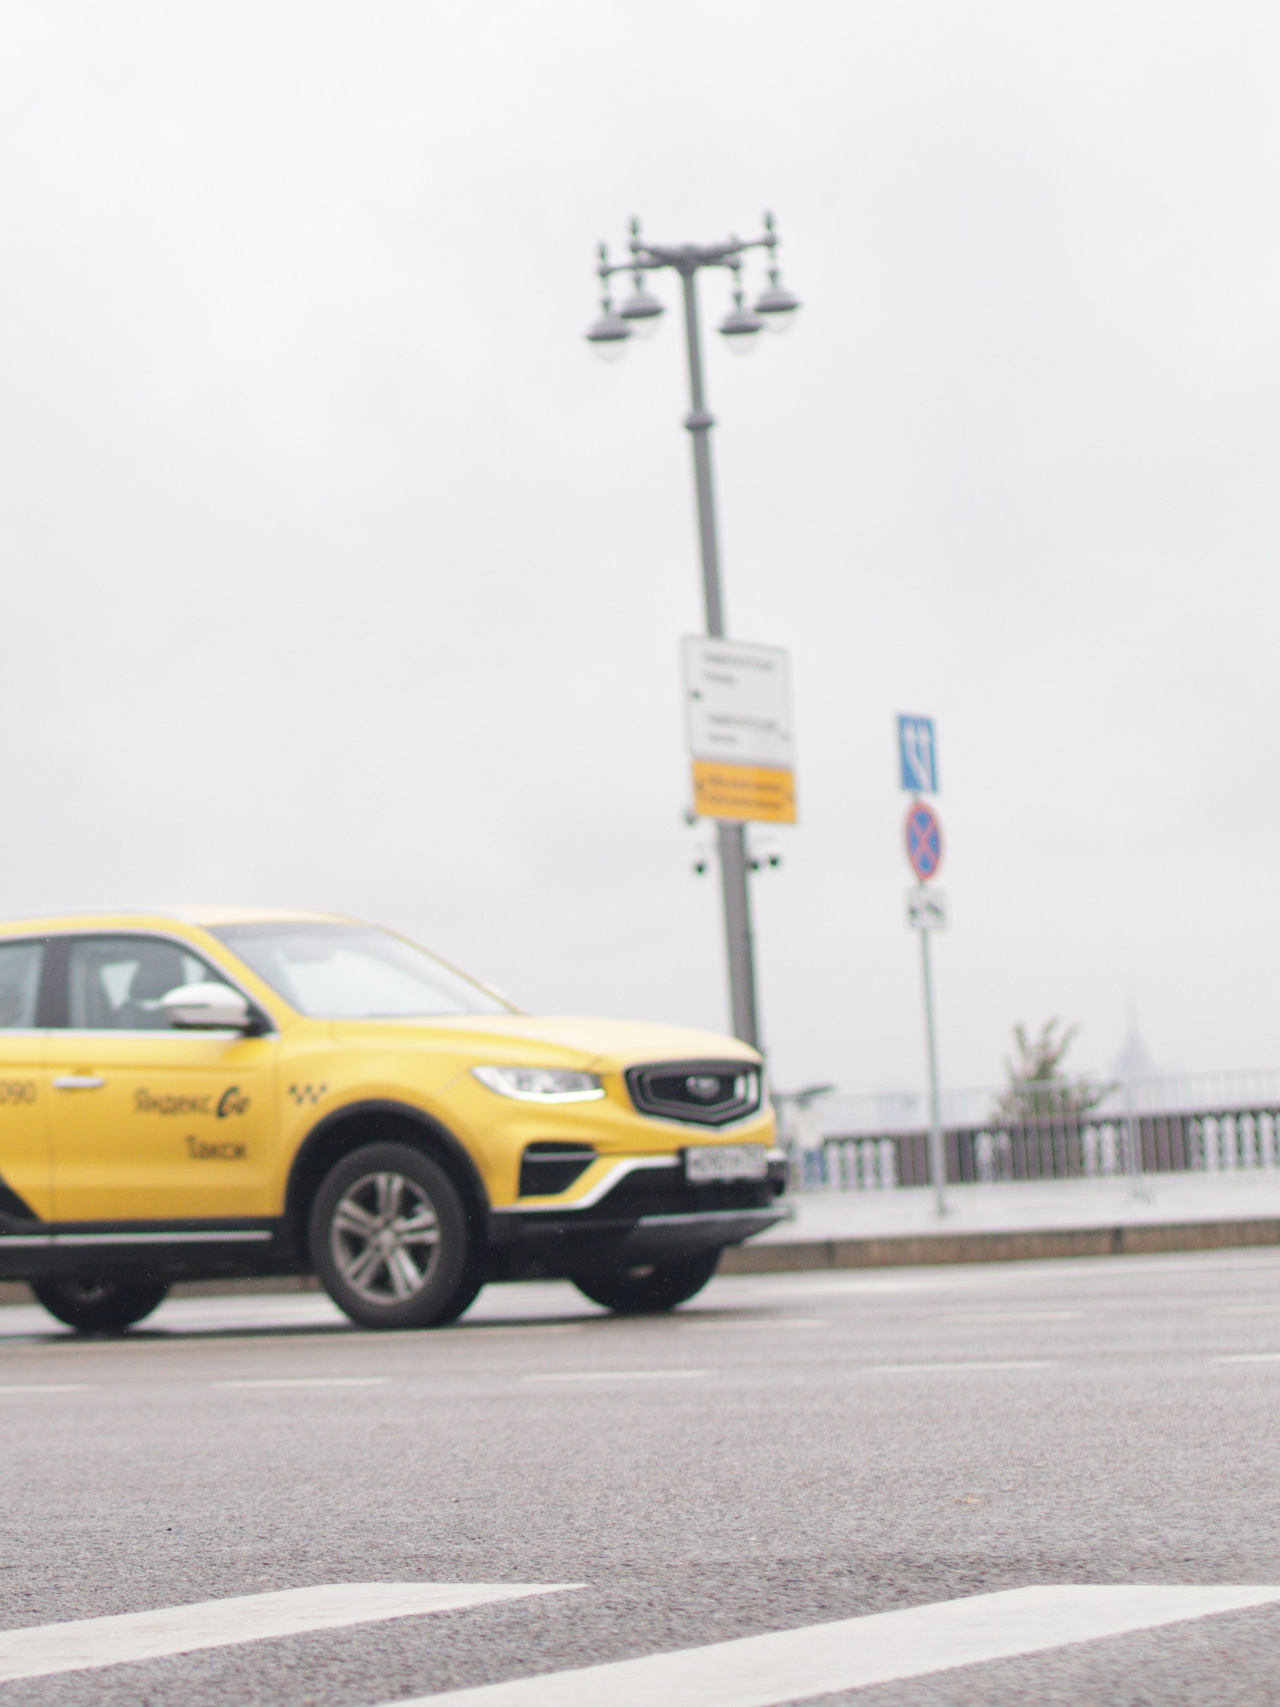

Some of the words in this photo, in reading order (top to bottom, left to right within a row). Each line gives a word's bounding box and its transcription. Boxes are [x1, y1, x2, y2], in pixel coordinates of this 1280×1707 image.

[134, 1087, 212, 1116] Яндекс
[216, 1085, 251, 1119] Go
[186, 1135, 247, 1161] Такси
